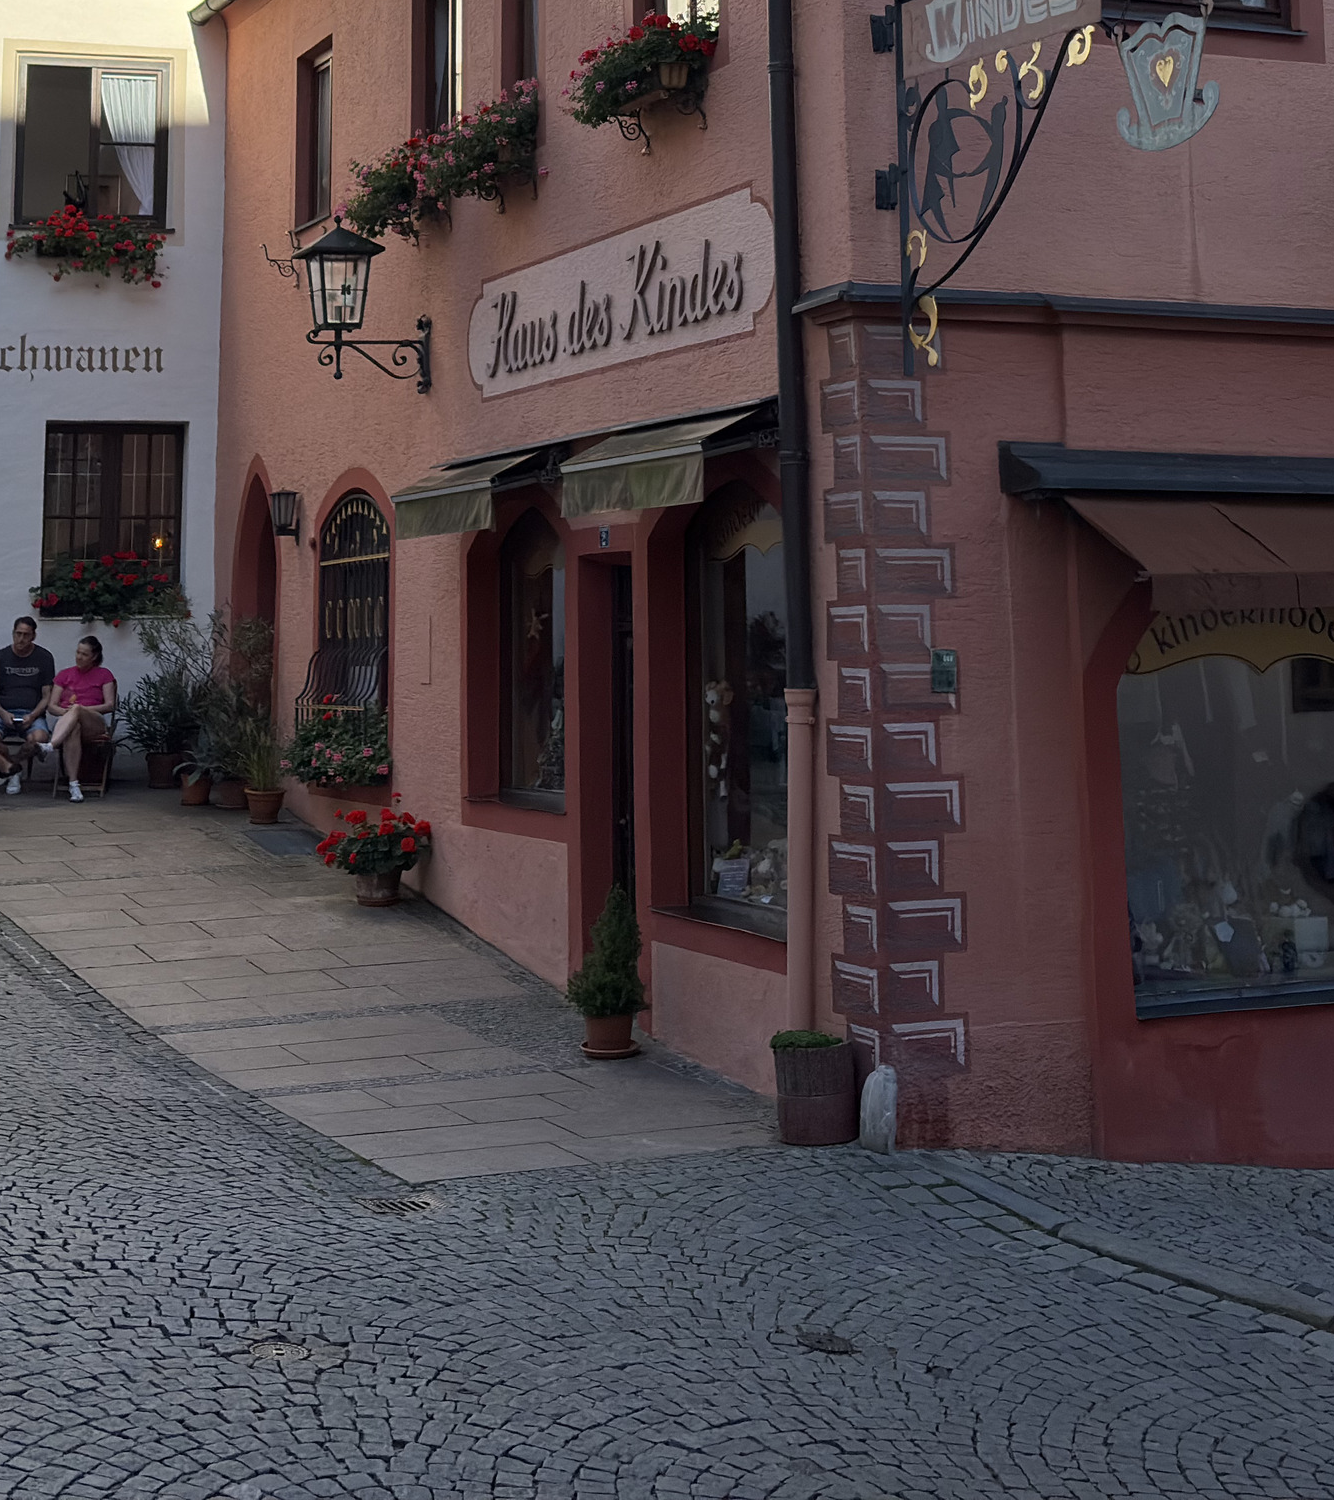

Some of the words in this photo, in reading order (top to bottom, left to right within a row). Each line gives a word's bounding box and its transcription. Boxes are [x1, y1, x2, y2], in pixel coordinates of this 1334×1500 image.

[486, 290, 558, 378] Haus
[562, 280, 612, 356] des
[619, 238, 745, 341] Kindes
